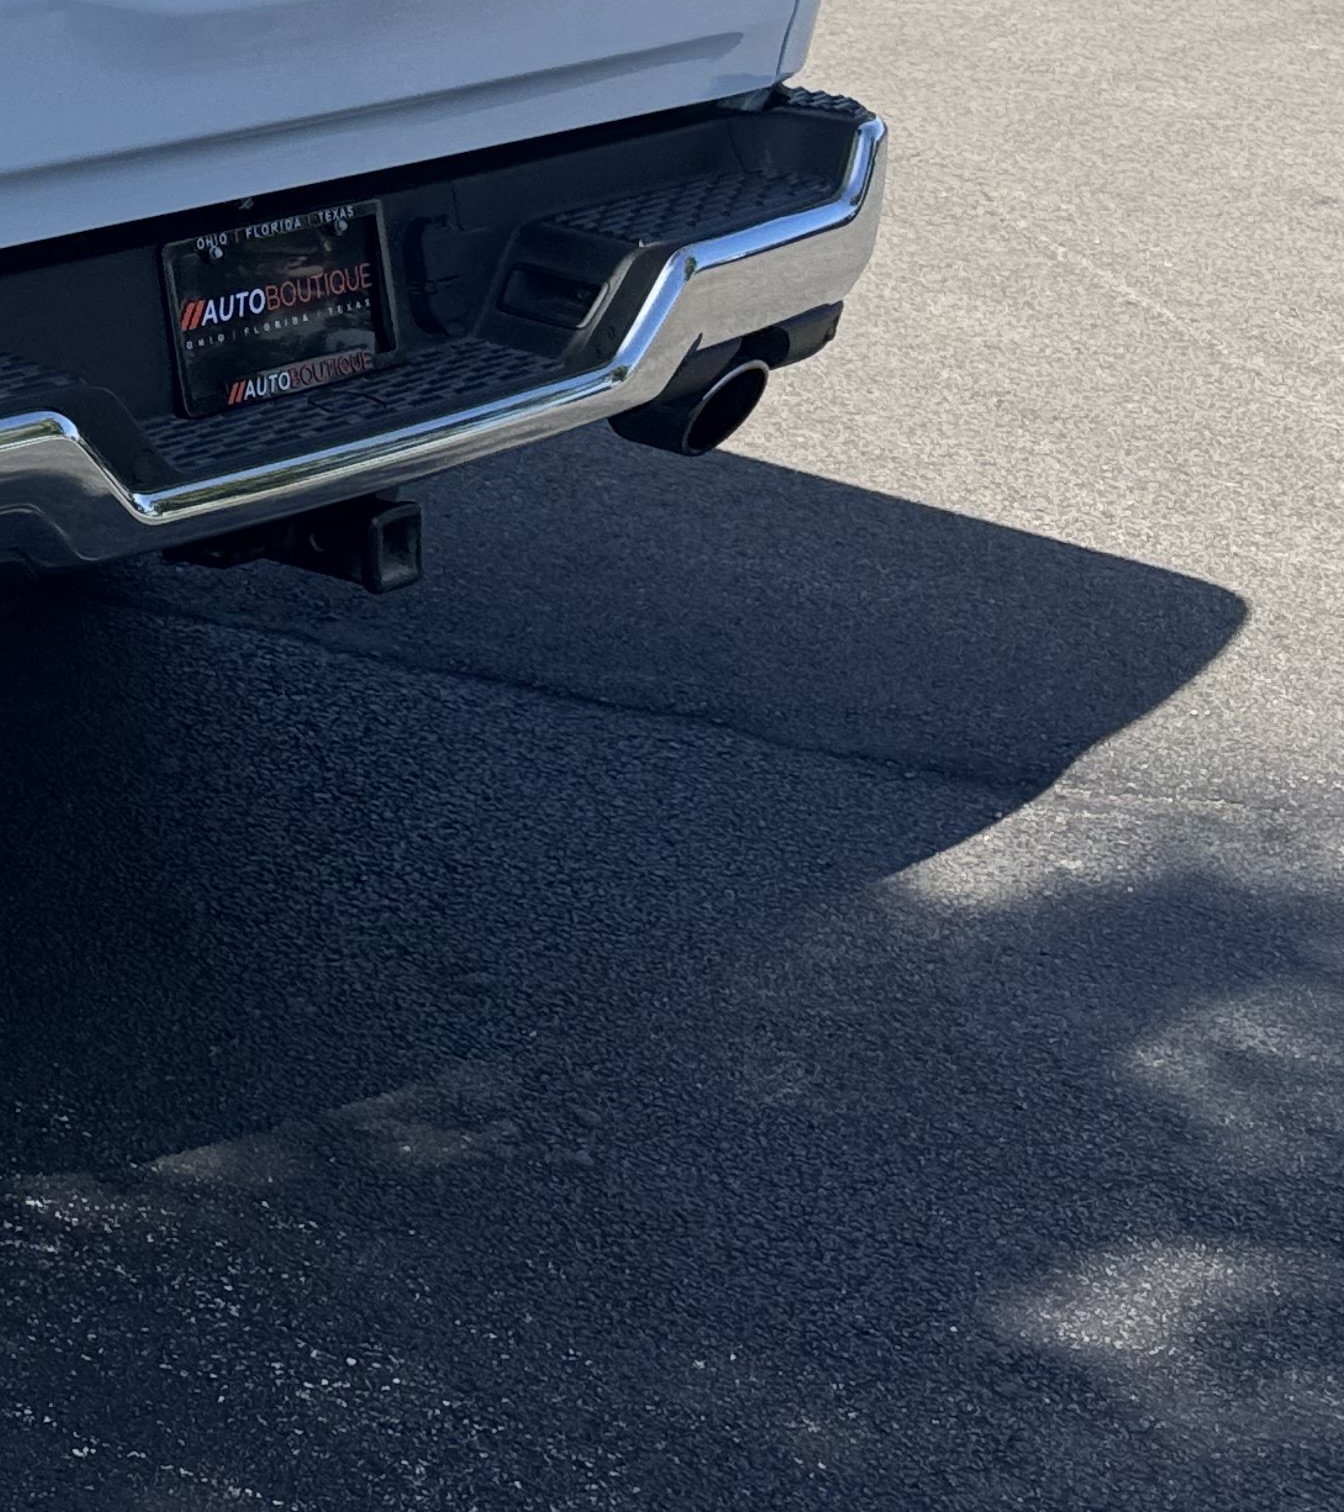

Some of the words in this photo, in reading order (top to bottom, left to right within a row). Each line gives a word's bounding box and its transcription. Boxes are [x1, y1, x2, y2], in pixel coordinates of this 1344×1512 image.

[196, 231, 228, 251] OHIO
[245, 217, 302, 239] FLORIDA
[317, 205, 355, 224] TEXAS
[185, 333, 226, 351] OHIO
[243, 314, 309, 337] FLORIDA
[327, 298, 372, 316] TEXAS
